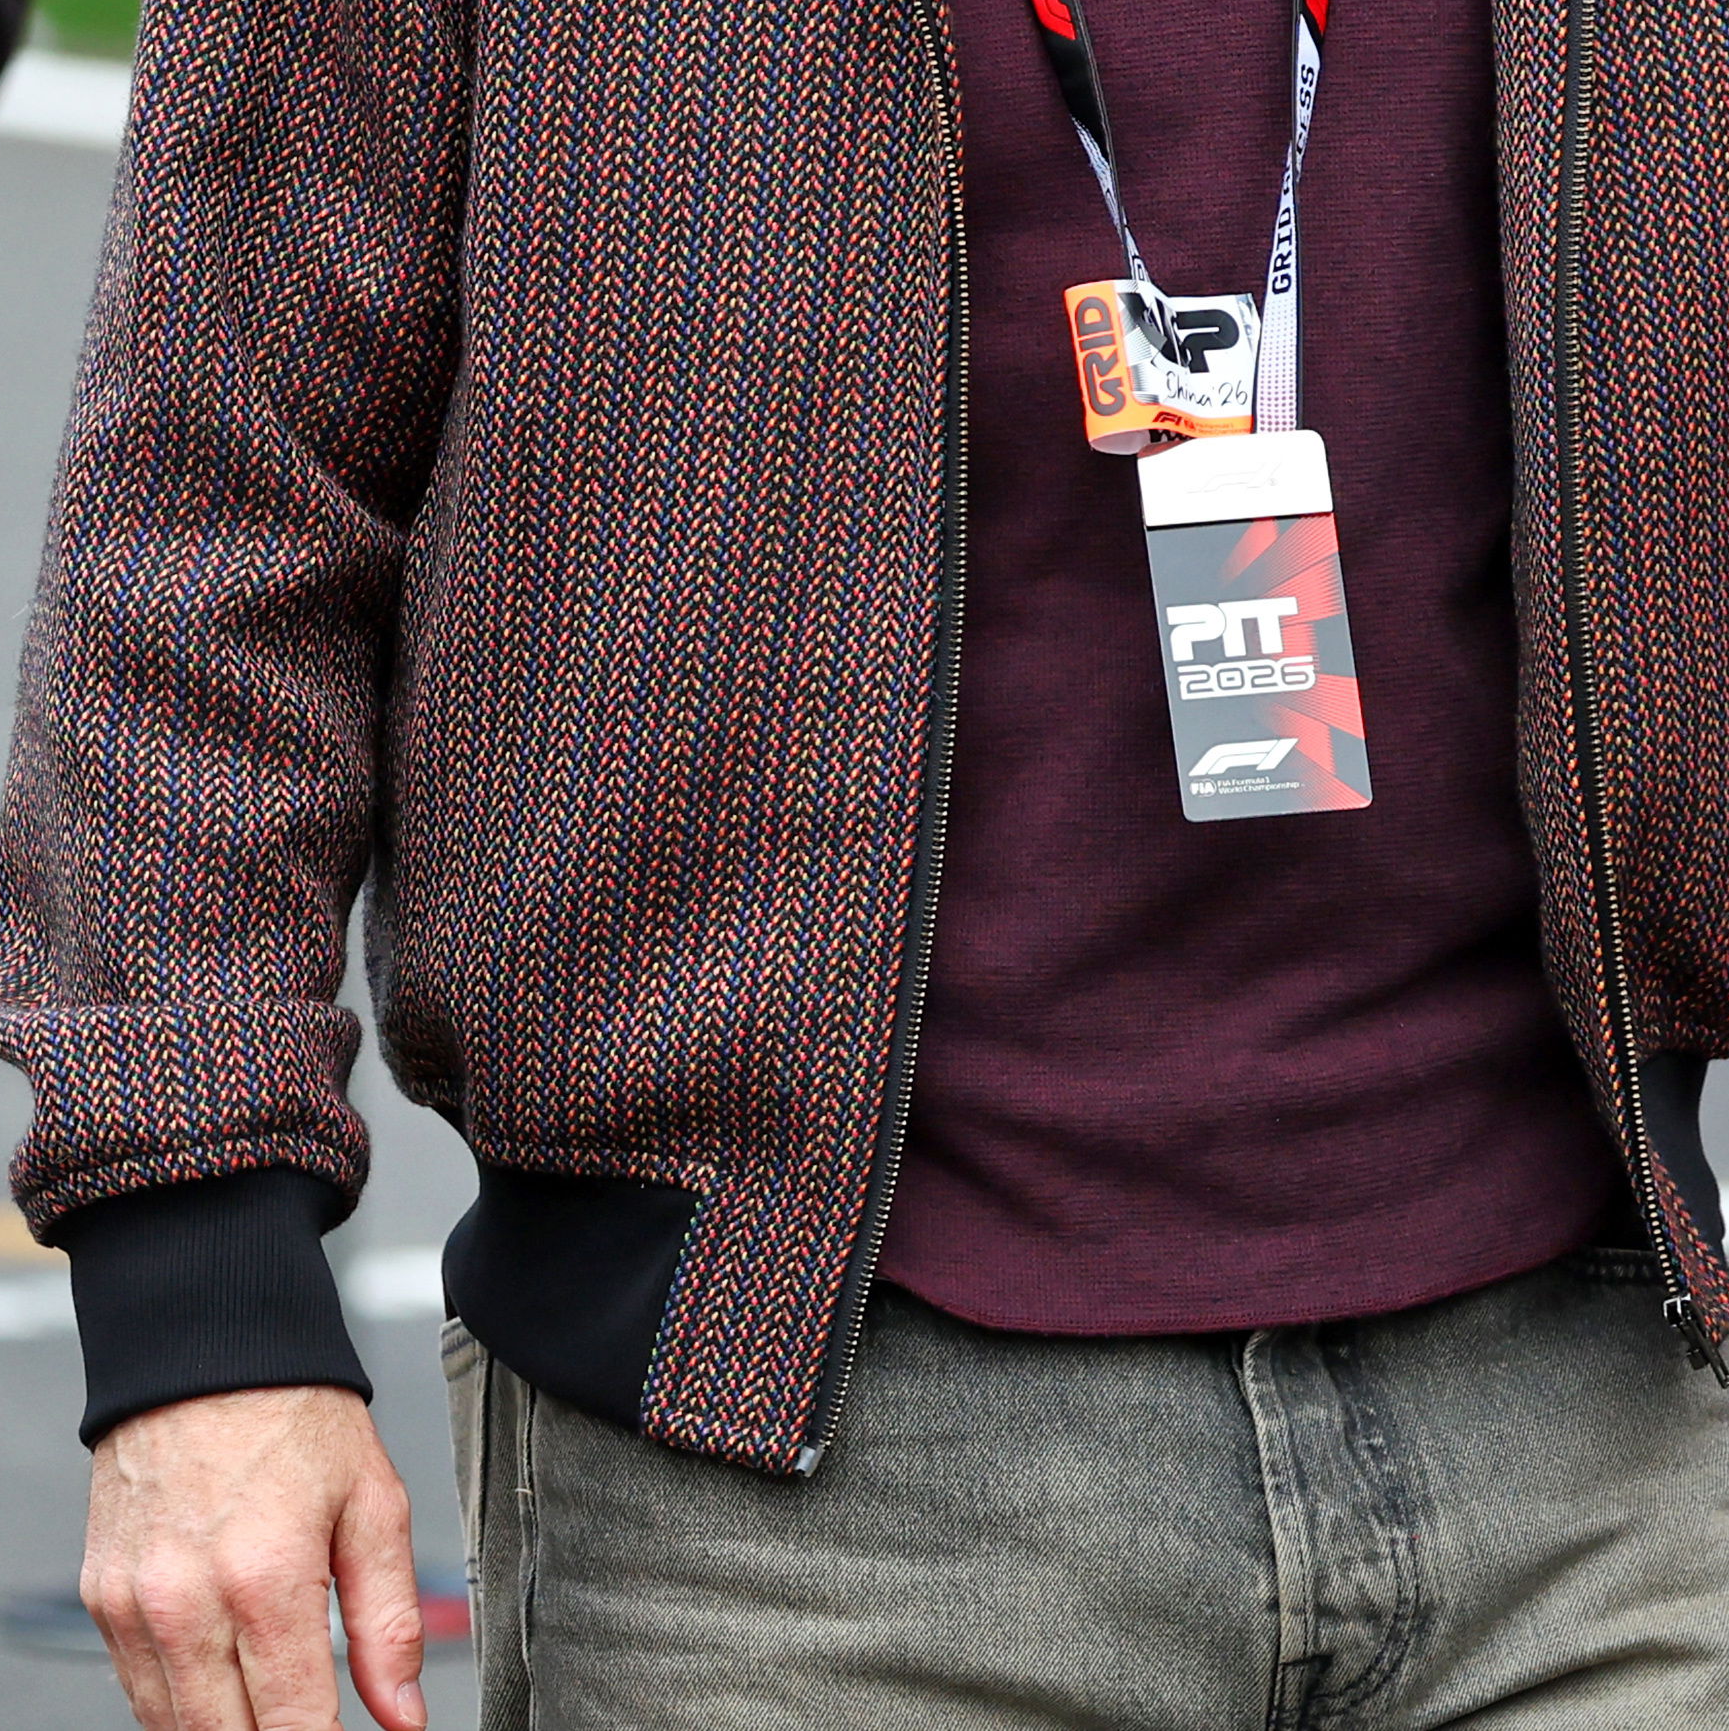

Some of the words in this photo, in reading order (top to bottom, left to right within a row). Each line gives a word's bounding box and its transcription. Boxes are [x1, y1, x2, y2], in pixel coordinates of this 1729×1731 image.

[1272, 207, 1292, 295] GRID
[1075, 297, 1126, 417] GRID
[1166, 596, 1299, 662] PIT
[1181, 661, 1313, 695] 2026
[1188, 738, 1299, 777] F1
